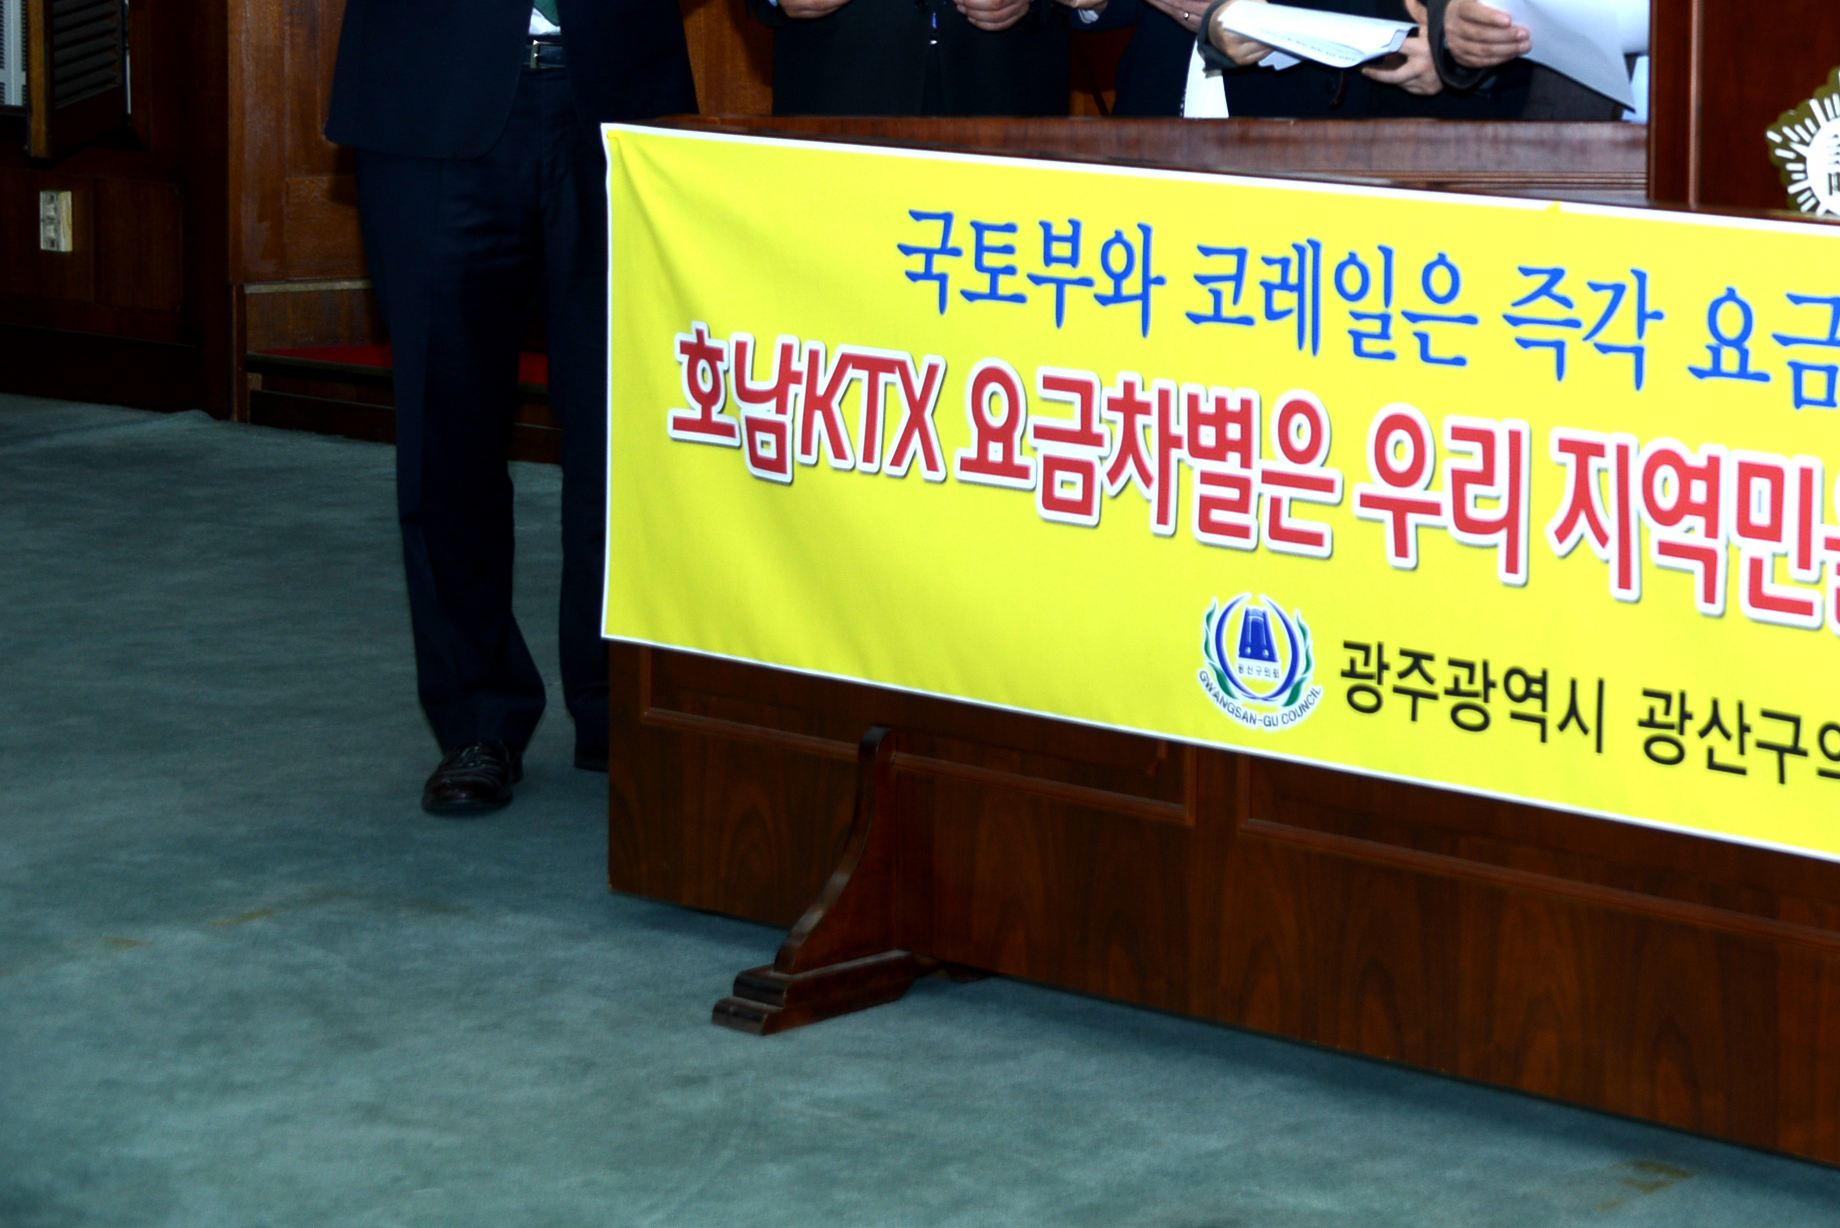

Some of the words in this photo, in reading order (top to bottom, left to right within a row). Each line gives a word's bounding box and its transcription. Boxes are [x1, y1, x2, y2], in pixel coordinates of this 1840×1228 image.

[897, 210, 1167, 338] 국토부와
[1185, 238, 1480, 368] 코레일은
[1502, 265, 1665, 391] 즉각
[672, 328, 939, 475] 호남KTX
[959, 367, 1335, 547] 요금차별은
[1359, 414, 1521, 575] 우리
[1199, 669, 1279, 727] GWANGSAN-GU
[1280, 686, 1322, 726] COUNCIL
[1340, 641, 1604, 754] 광주광역시
